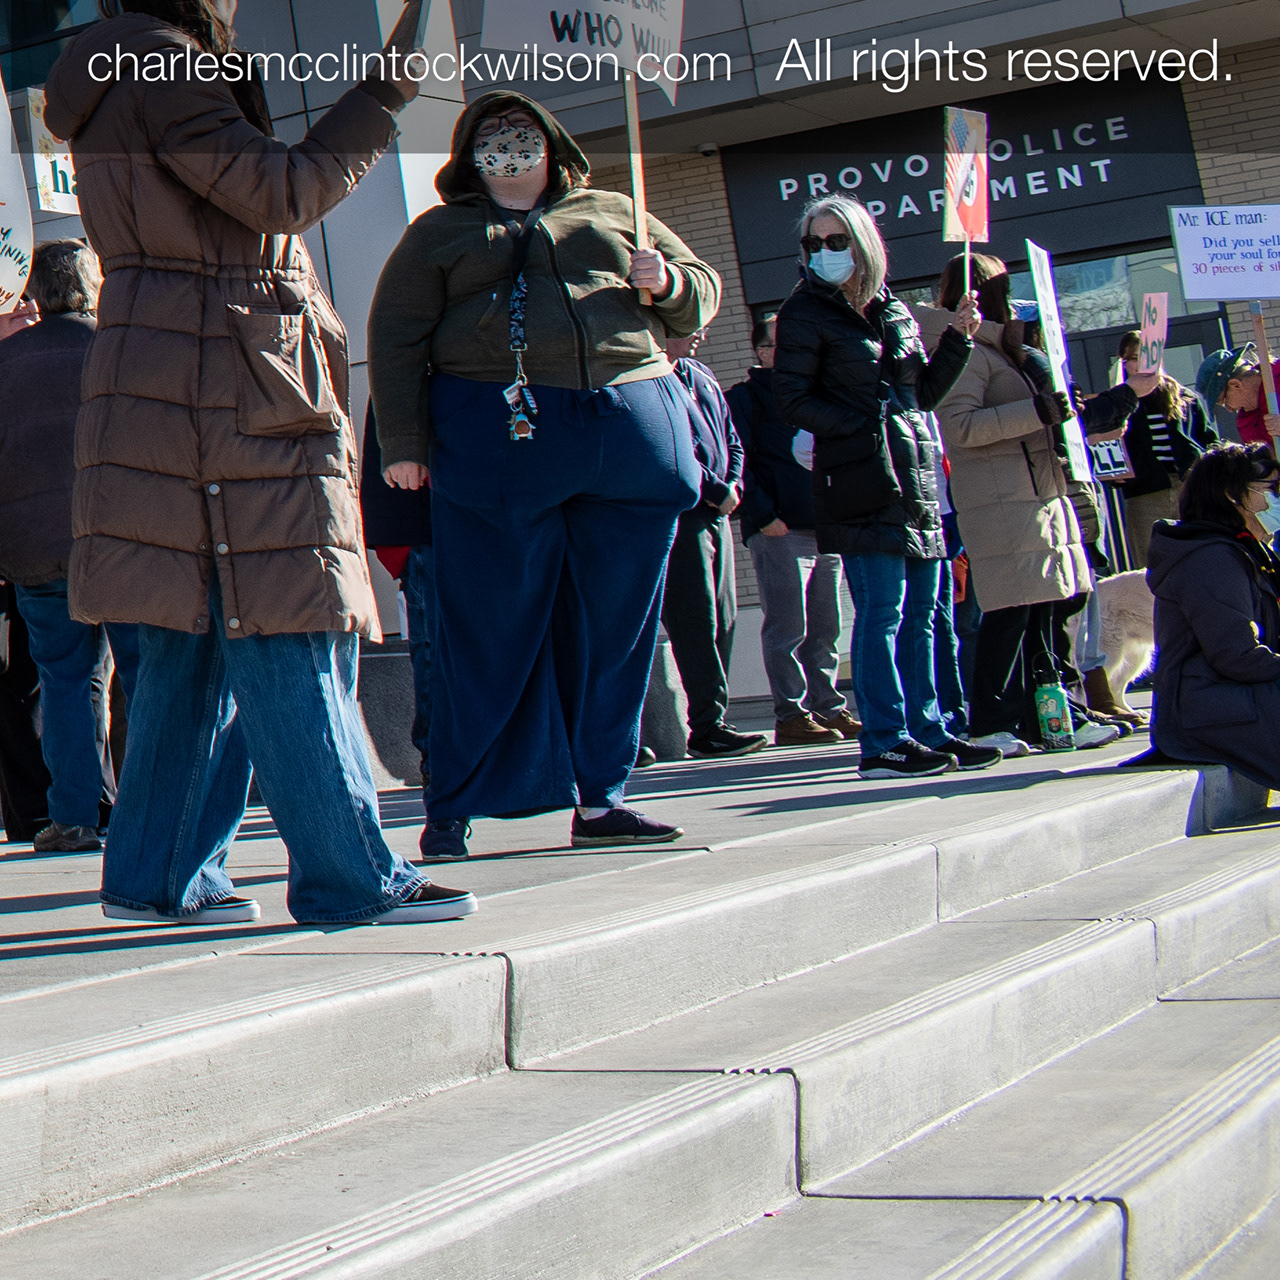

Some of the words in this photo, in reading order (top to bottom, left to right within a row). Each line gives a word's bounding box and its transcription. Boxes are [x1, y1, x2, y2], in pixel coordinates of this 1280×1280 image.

[550, 9, 623, 48] WHO
[779, 154, 930, 201] PROVO
[986, 116, 1129, 162] OLICE
[867, 158, 1114, 220] PARMENT
[1205, 211, 1231, 226] ICE
[1235, 212, 1268, 225] man:
[1202, 236, 1227, 248] Did
[1231, 238, 1254, 250] you
[1208, 252, 1237, 263] your
[1240, 249, 1263, 260] soul
[1192, 263, 1207, 275] 30
[1212, 264, 1246, 276] pieces
[1253, 261, 1264, 272] of
[1143, 296, 1158, 329] No
